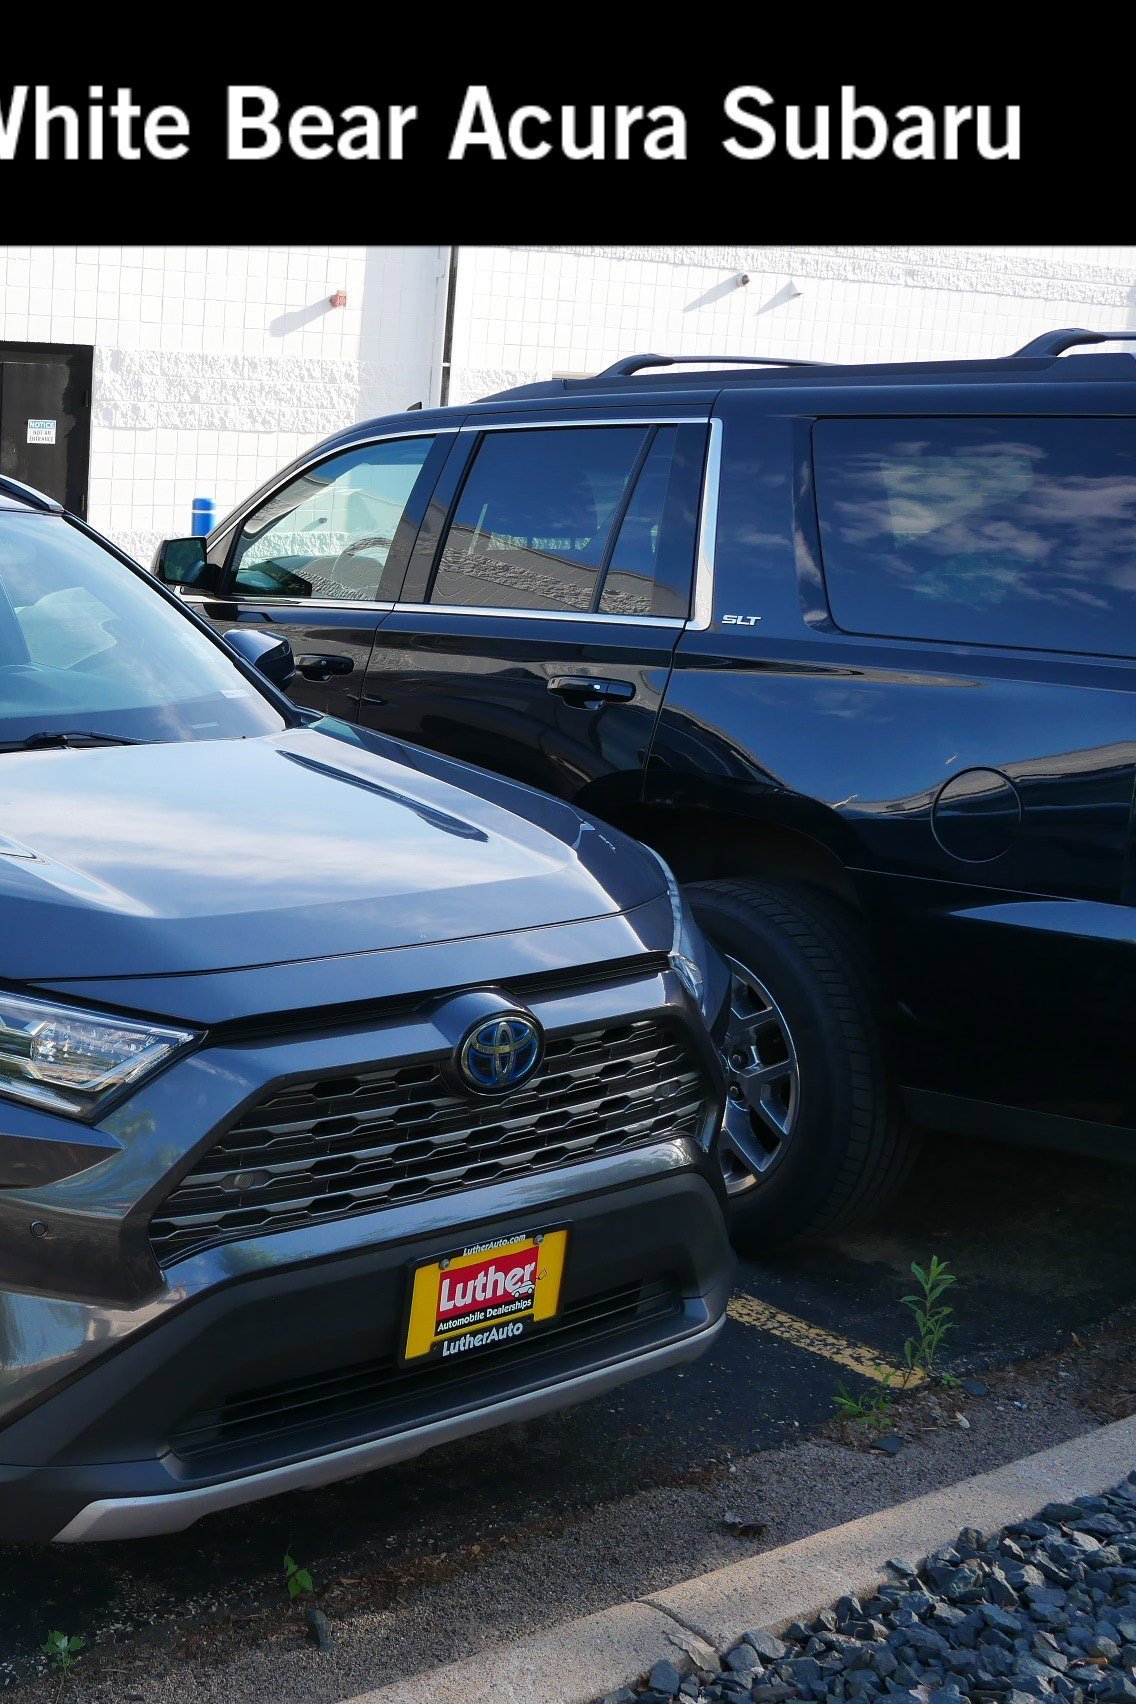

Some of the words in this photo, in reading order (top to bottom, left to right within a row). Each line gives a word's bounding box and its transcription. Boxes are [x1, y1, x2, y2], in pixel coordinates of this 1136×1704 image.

[29, 421, 55, 429] NOTICE
[722, 614, 761, 626] SLT
[463, 1234, 526, 1256] LutherAuto.com
[440, 1262, 536, 1311] Luther
[437, 1312, 485, 1332] Automobile
[486, 1299, 532, 1318] Dealerships
[442, 1322, 524, 1357] LutherAuto
